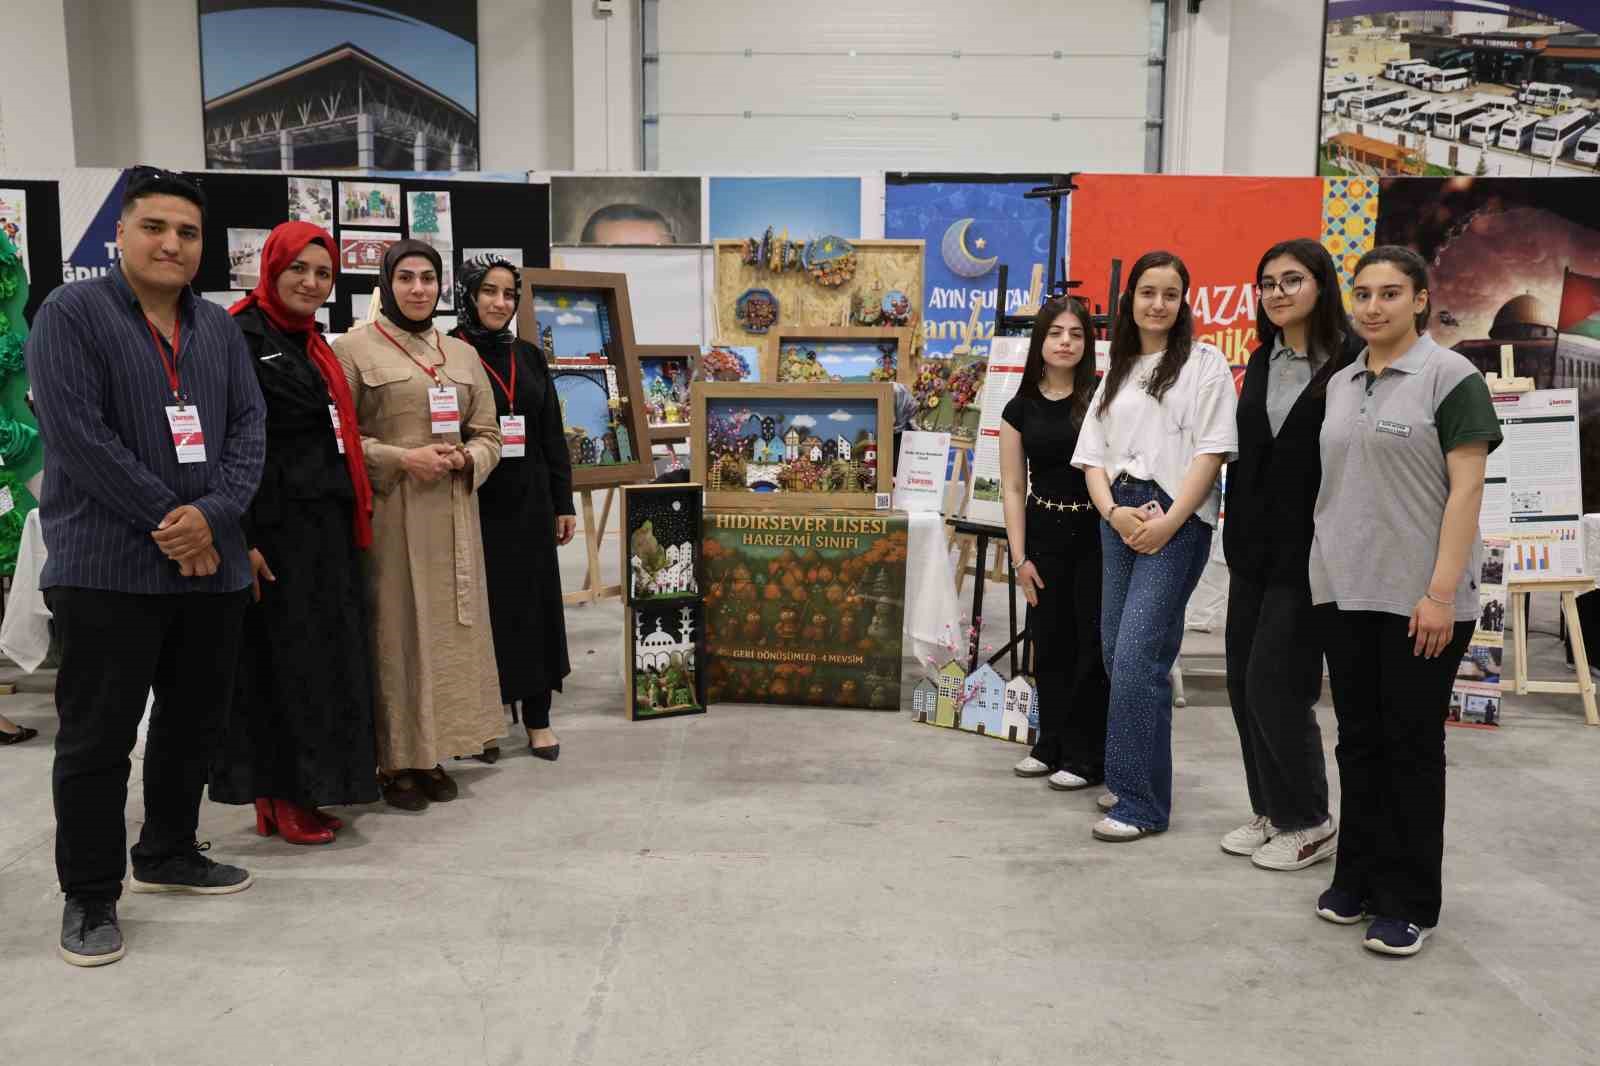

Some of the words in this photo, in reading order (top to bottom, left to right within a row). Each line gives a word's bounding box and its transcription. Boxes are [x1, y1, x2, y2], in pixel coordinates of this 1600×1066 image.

[928, 287, 966, 309] AYIN
[716, 514, 827, 533] HIDIRSEVER
[742, 532, 811, 547] HAREZMİ
